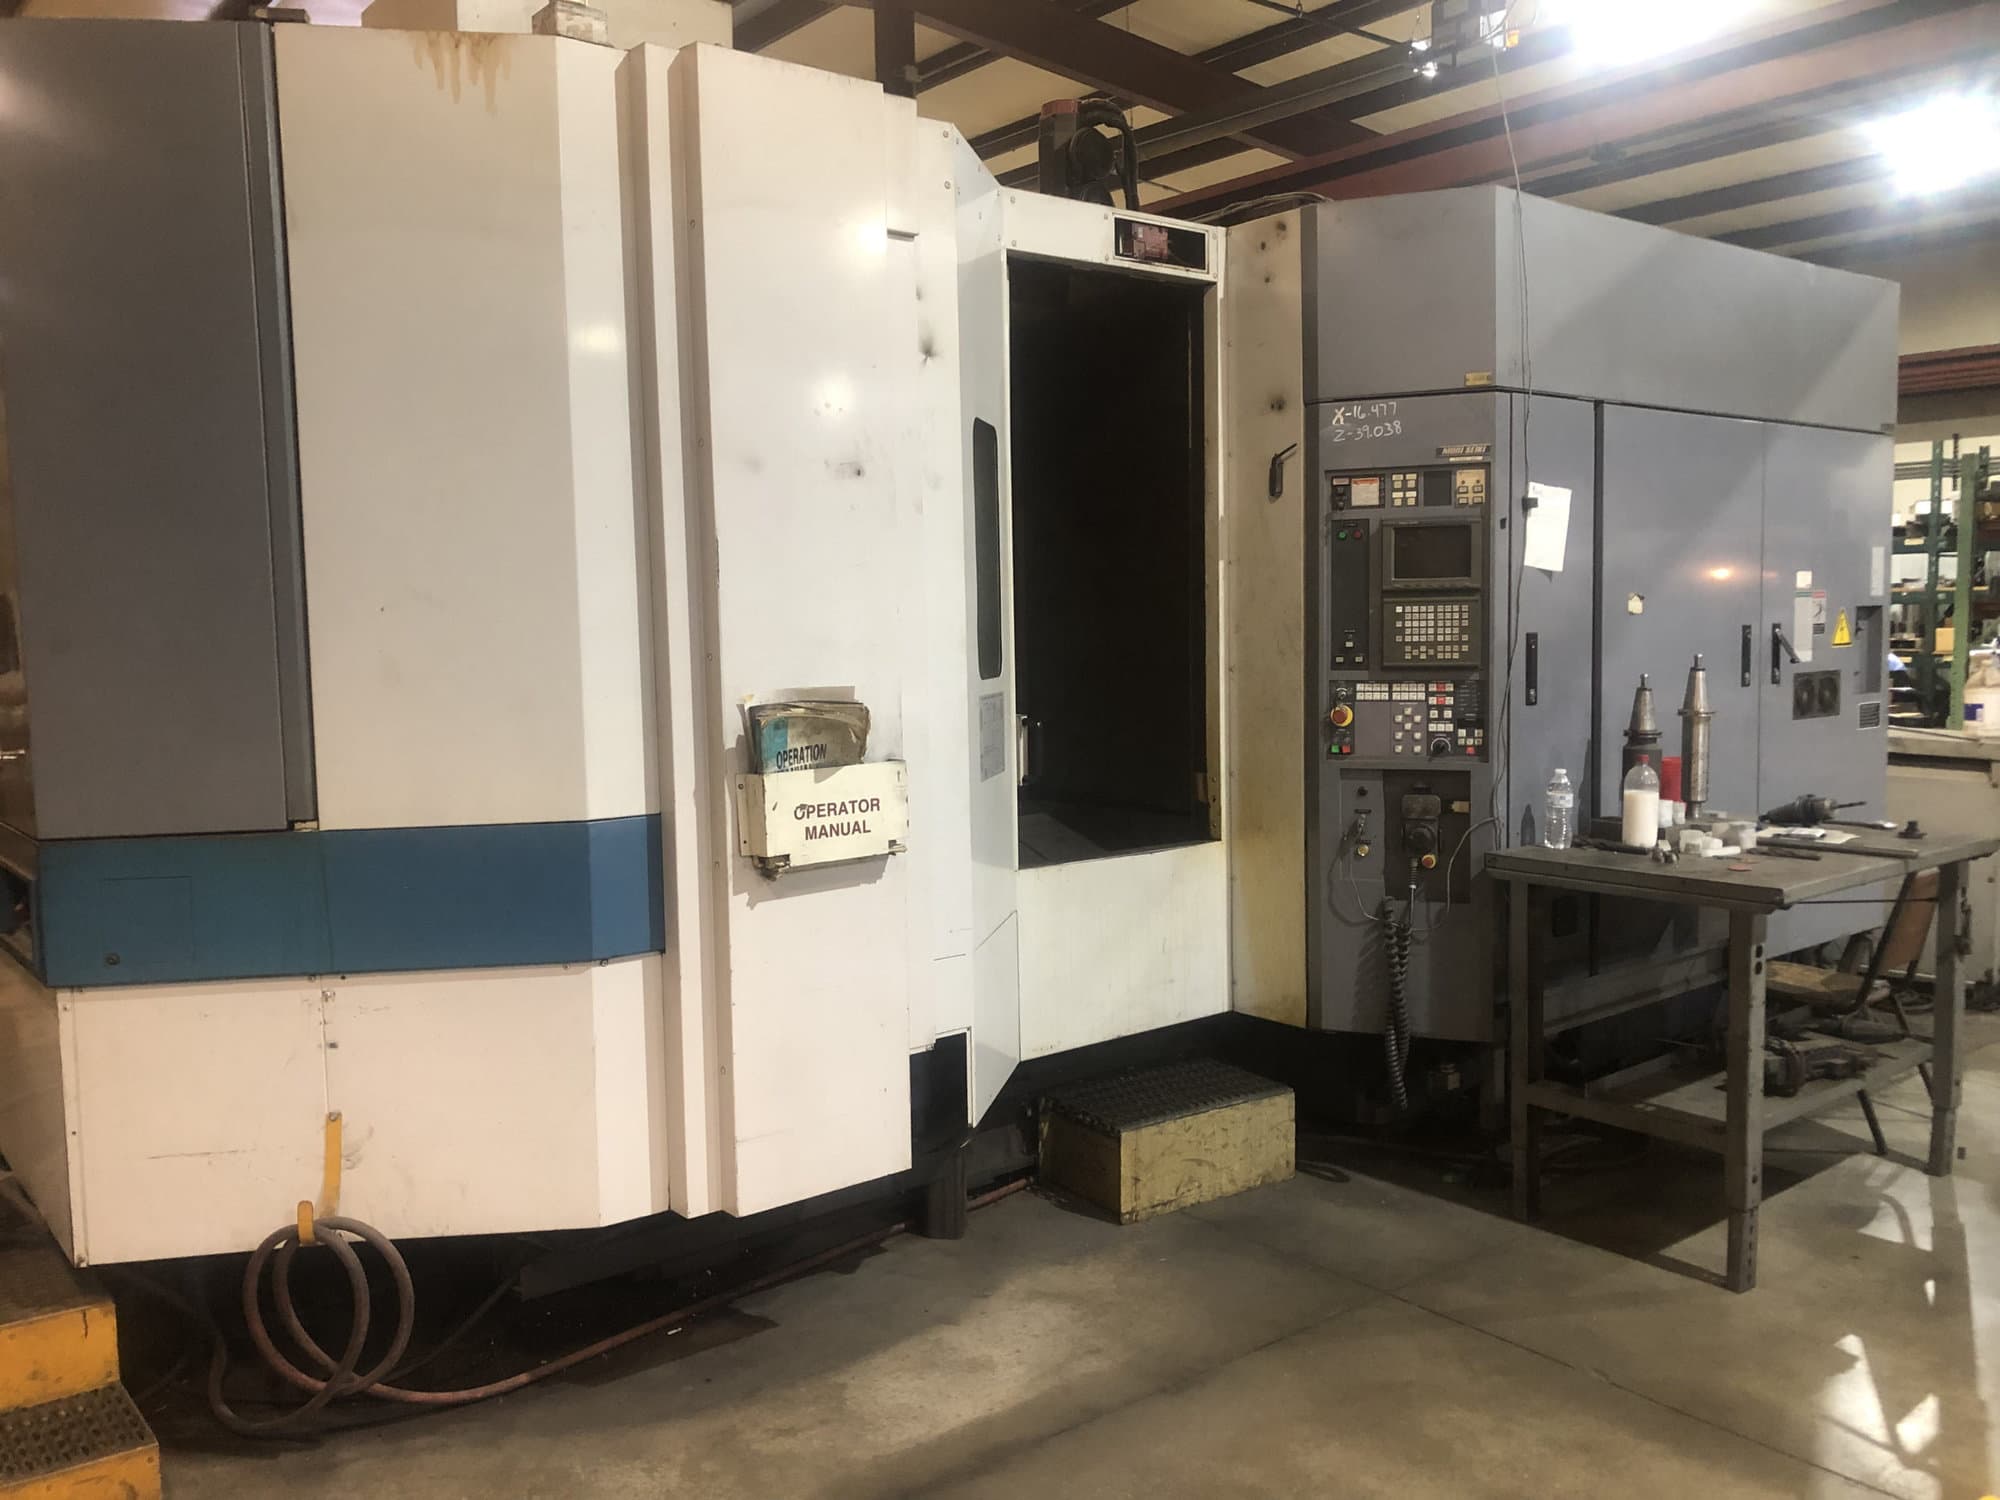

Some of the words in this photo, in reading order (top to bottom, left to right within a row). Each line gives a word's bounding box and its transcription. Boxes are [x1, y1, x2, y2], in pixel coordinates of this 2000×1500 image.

[1332, 402, 1397, 425] X-16.477
[1333, 420, 1402, 442] Z-39.038
[776, 743, 827, 769] OPERATION
[794, 798, 880, 820] OPERATOR
[805, 820, 871, 840] MANUAL
